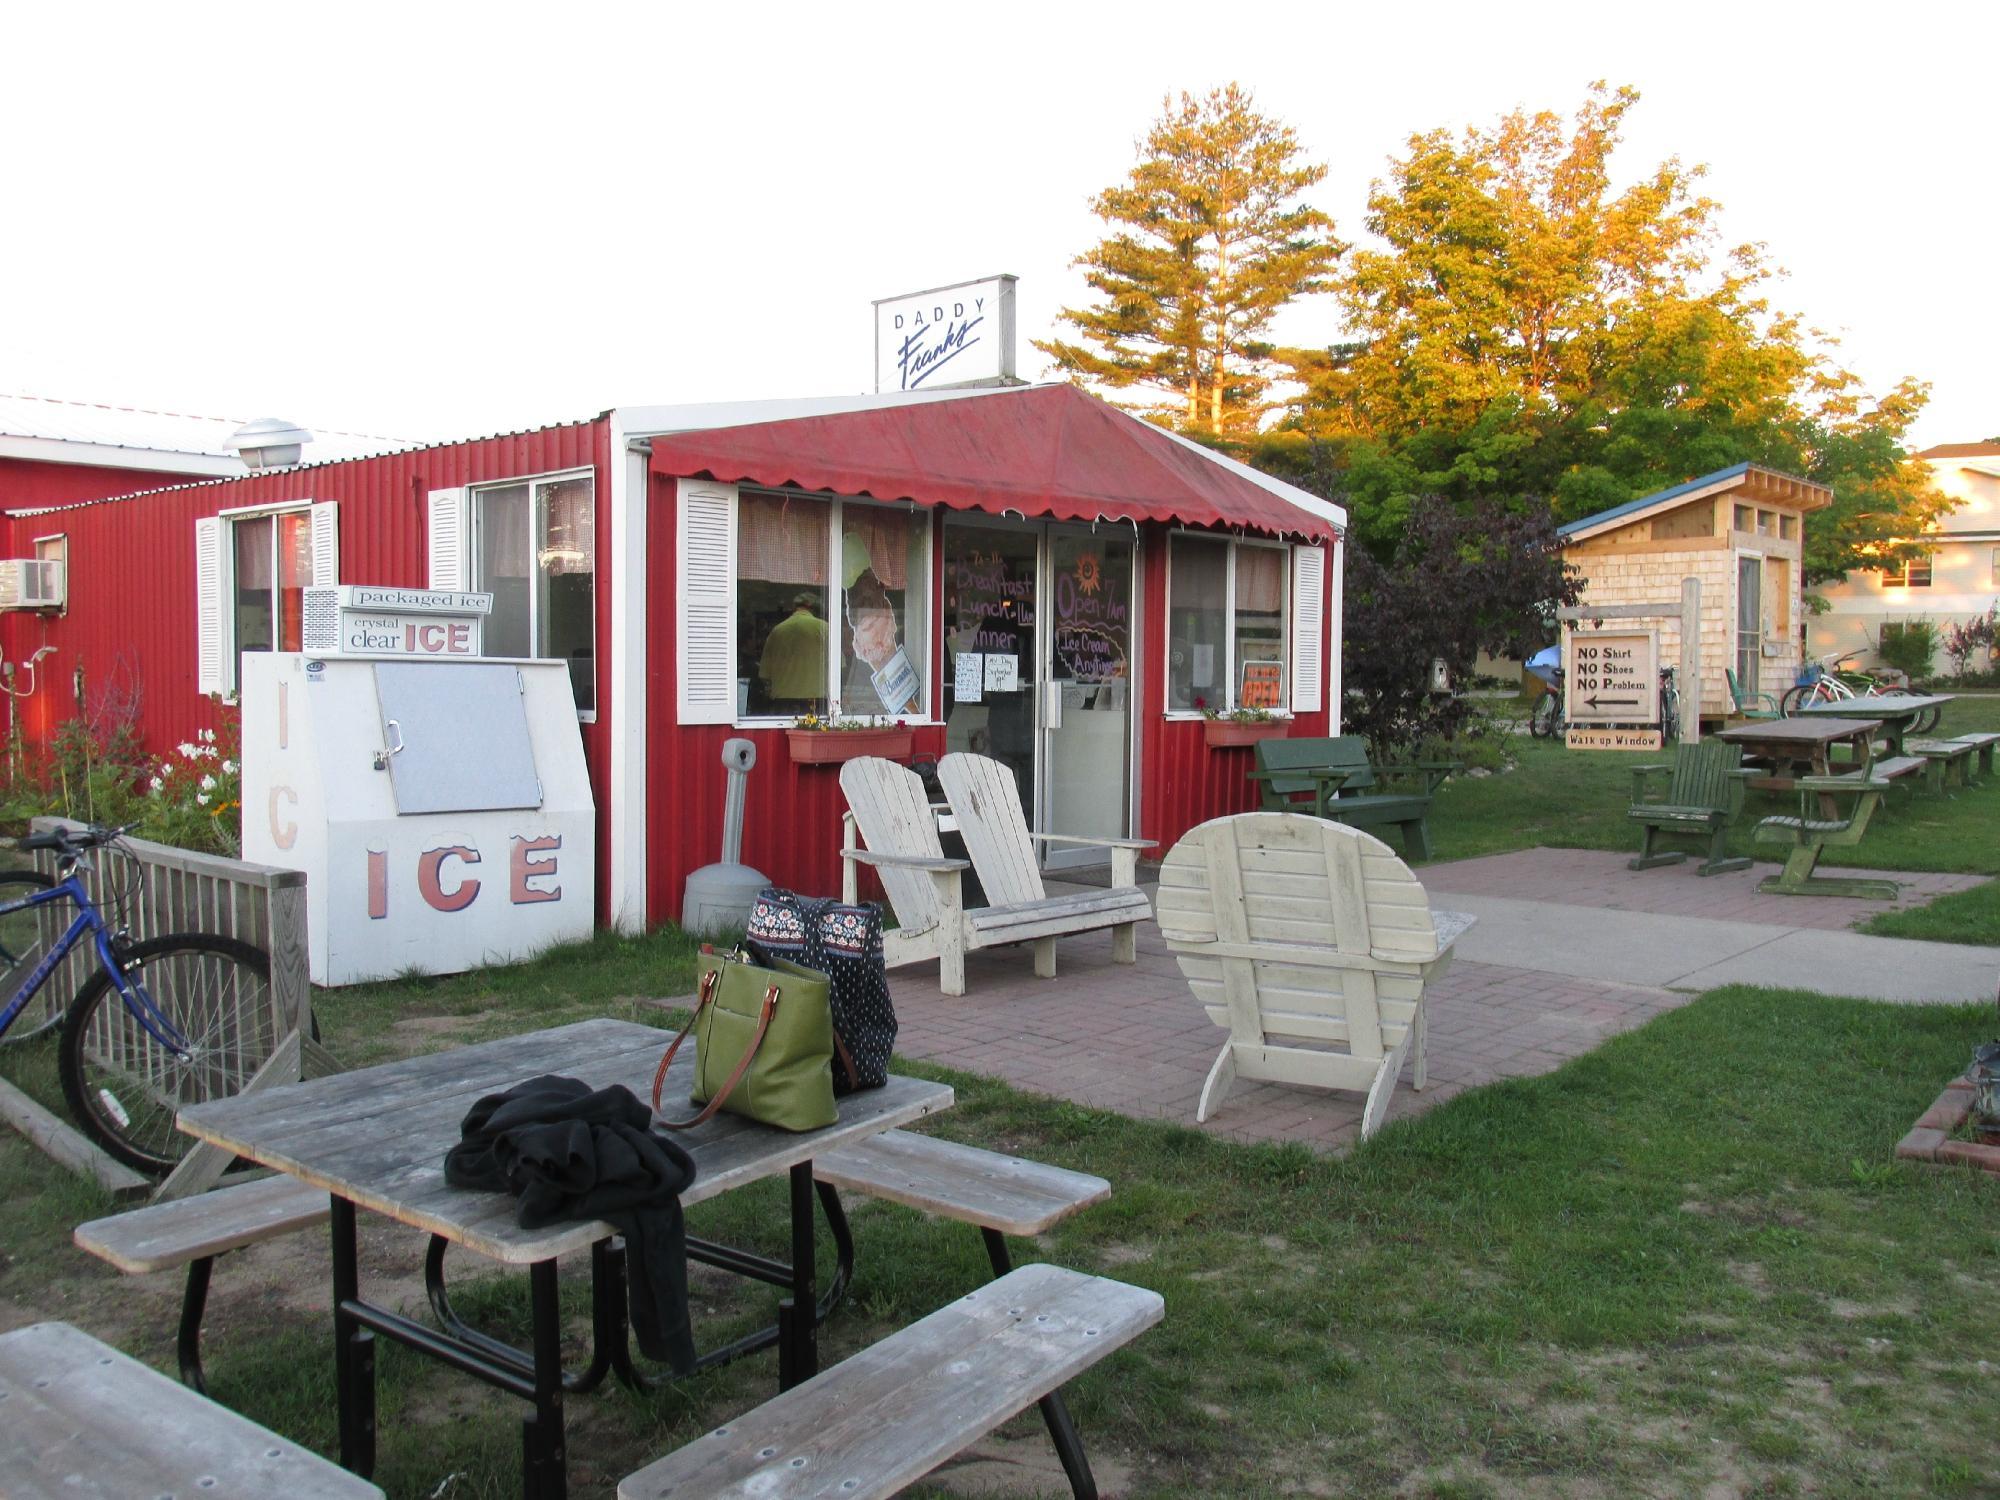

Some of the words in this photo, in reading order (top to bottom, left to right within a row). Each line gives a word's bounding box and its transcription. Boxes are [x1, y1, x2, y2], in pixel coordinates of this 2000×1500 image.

[895, 297, 984, 329] DADDY
[898, 316, 984, 390] Franks
[360, 592, 453, 608] packaged
[460, 595, 486, 608] ice
[354, 618, 399, 628] crystal
[351, 630, 400, 649] clear
[405, 623, 470, 653] ICE
[1577, 648, 1598, 659] NO
[1603, 647, 1631, 659] Shirt
[1577, 663, 1598, 675] NO
[1603, 663, 1634, 674] Shoes
[1577, 679, 1598, 690] NO
[1603, 678, 1645, 690] Problem
[1570, 735, 1595, 745] Walk
[1600, 737, 1611, 747] up
[1616, 735, 1656, 746] Window
[367, 832, 562, 919] ICE
